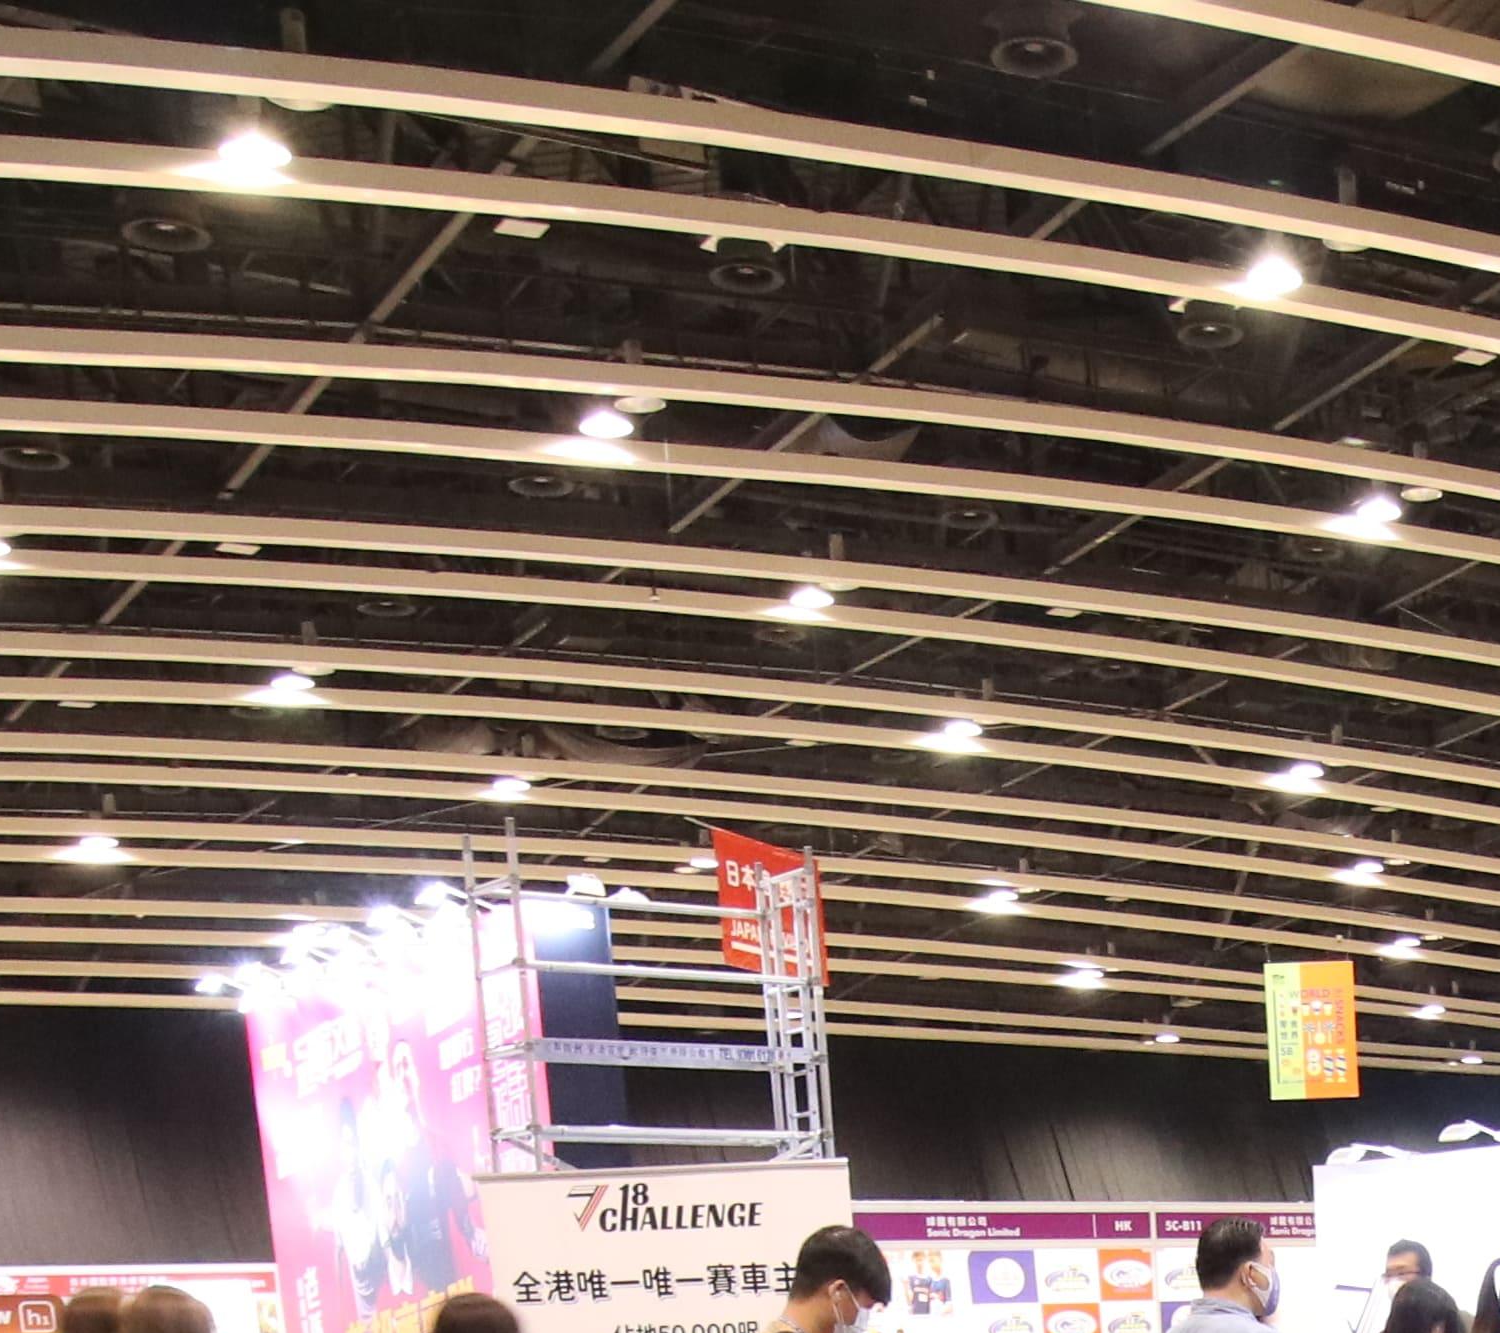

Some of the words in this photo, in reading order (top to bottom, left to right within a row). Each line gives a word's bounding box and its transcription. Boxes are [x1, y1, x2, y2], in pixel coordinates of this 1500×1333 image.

[599, 1201, 763, 1233] CHALLENGE
[1114, 1220, 1133, 1231] HK
[1164, 1220, 1203, 1231] 5C-B11
[987, 1227, 1021, 1237] Limited
[512, 1262, 798, 1304] 全港唯一唯一賽車主
